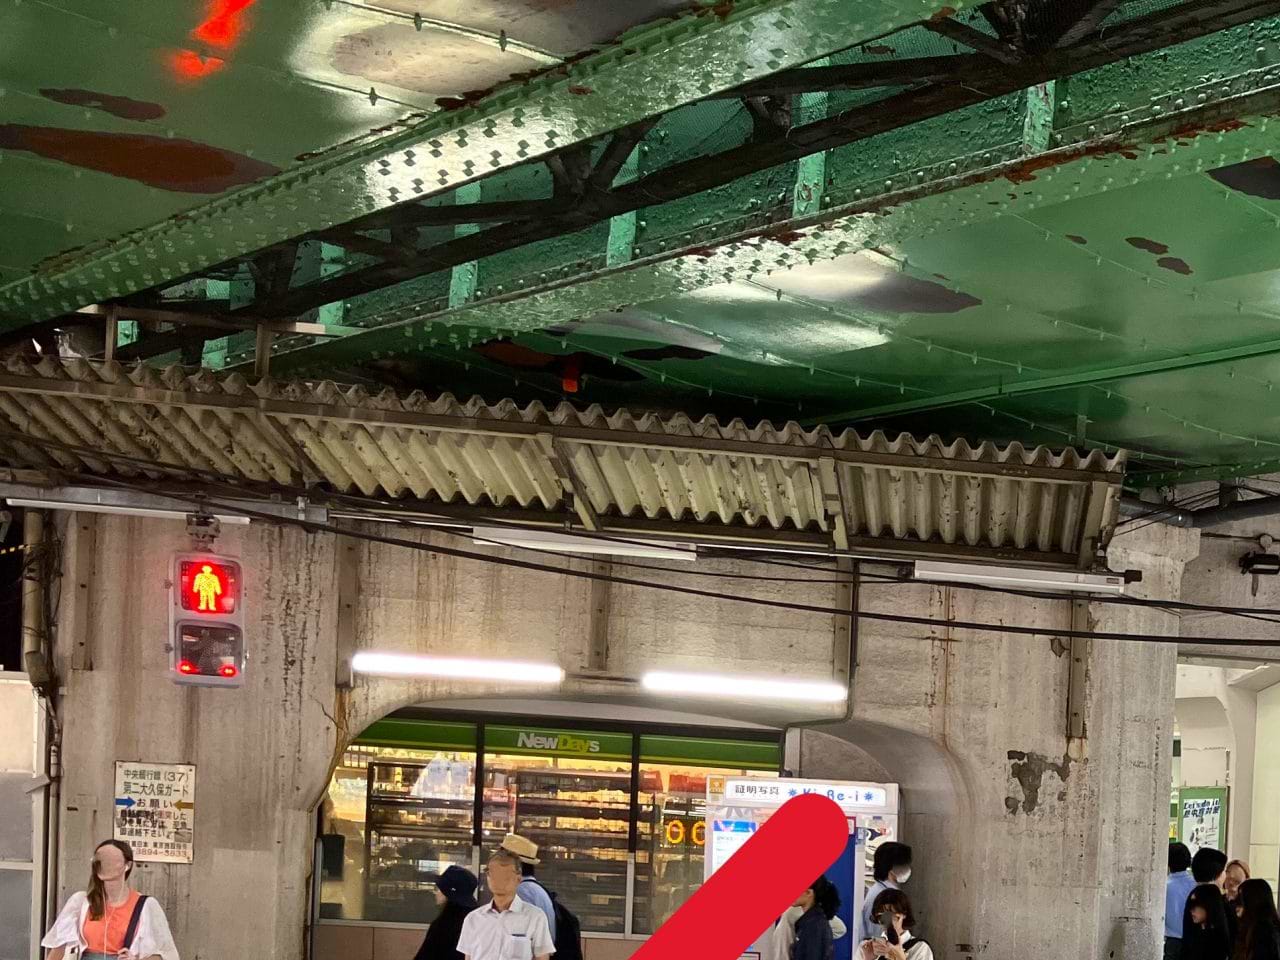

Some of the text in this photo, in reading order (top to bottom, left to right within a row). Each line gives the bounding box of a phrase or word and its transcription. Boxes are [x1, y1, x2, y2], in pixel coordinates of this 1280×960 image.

[517, 732, 600, 753] NewDays
[123, 781, 189, 797] 第二大久保ガード
[735, 784, 779, 795] 証明写真
